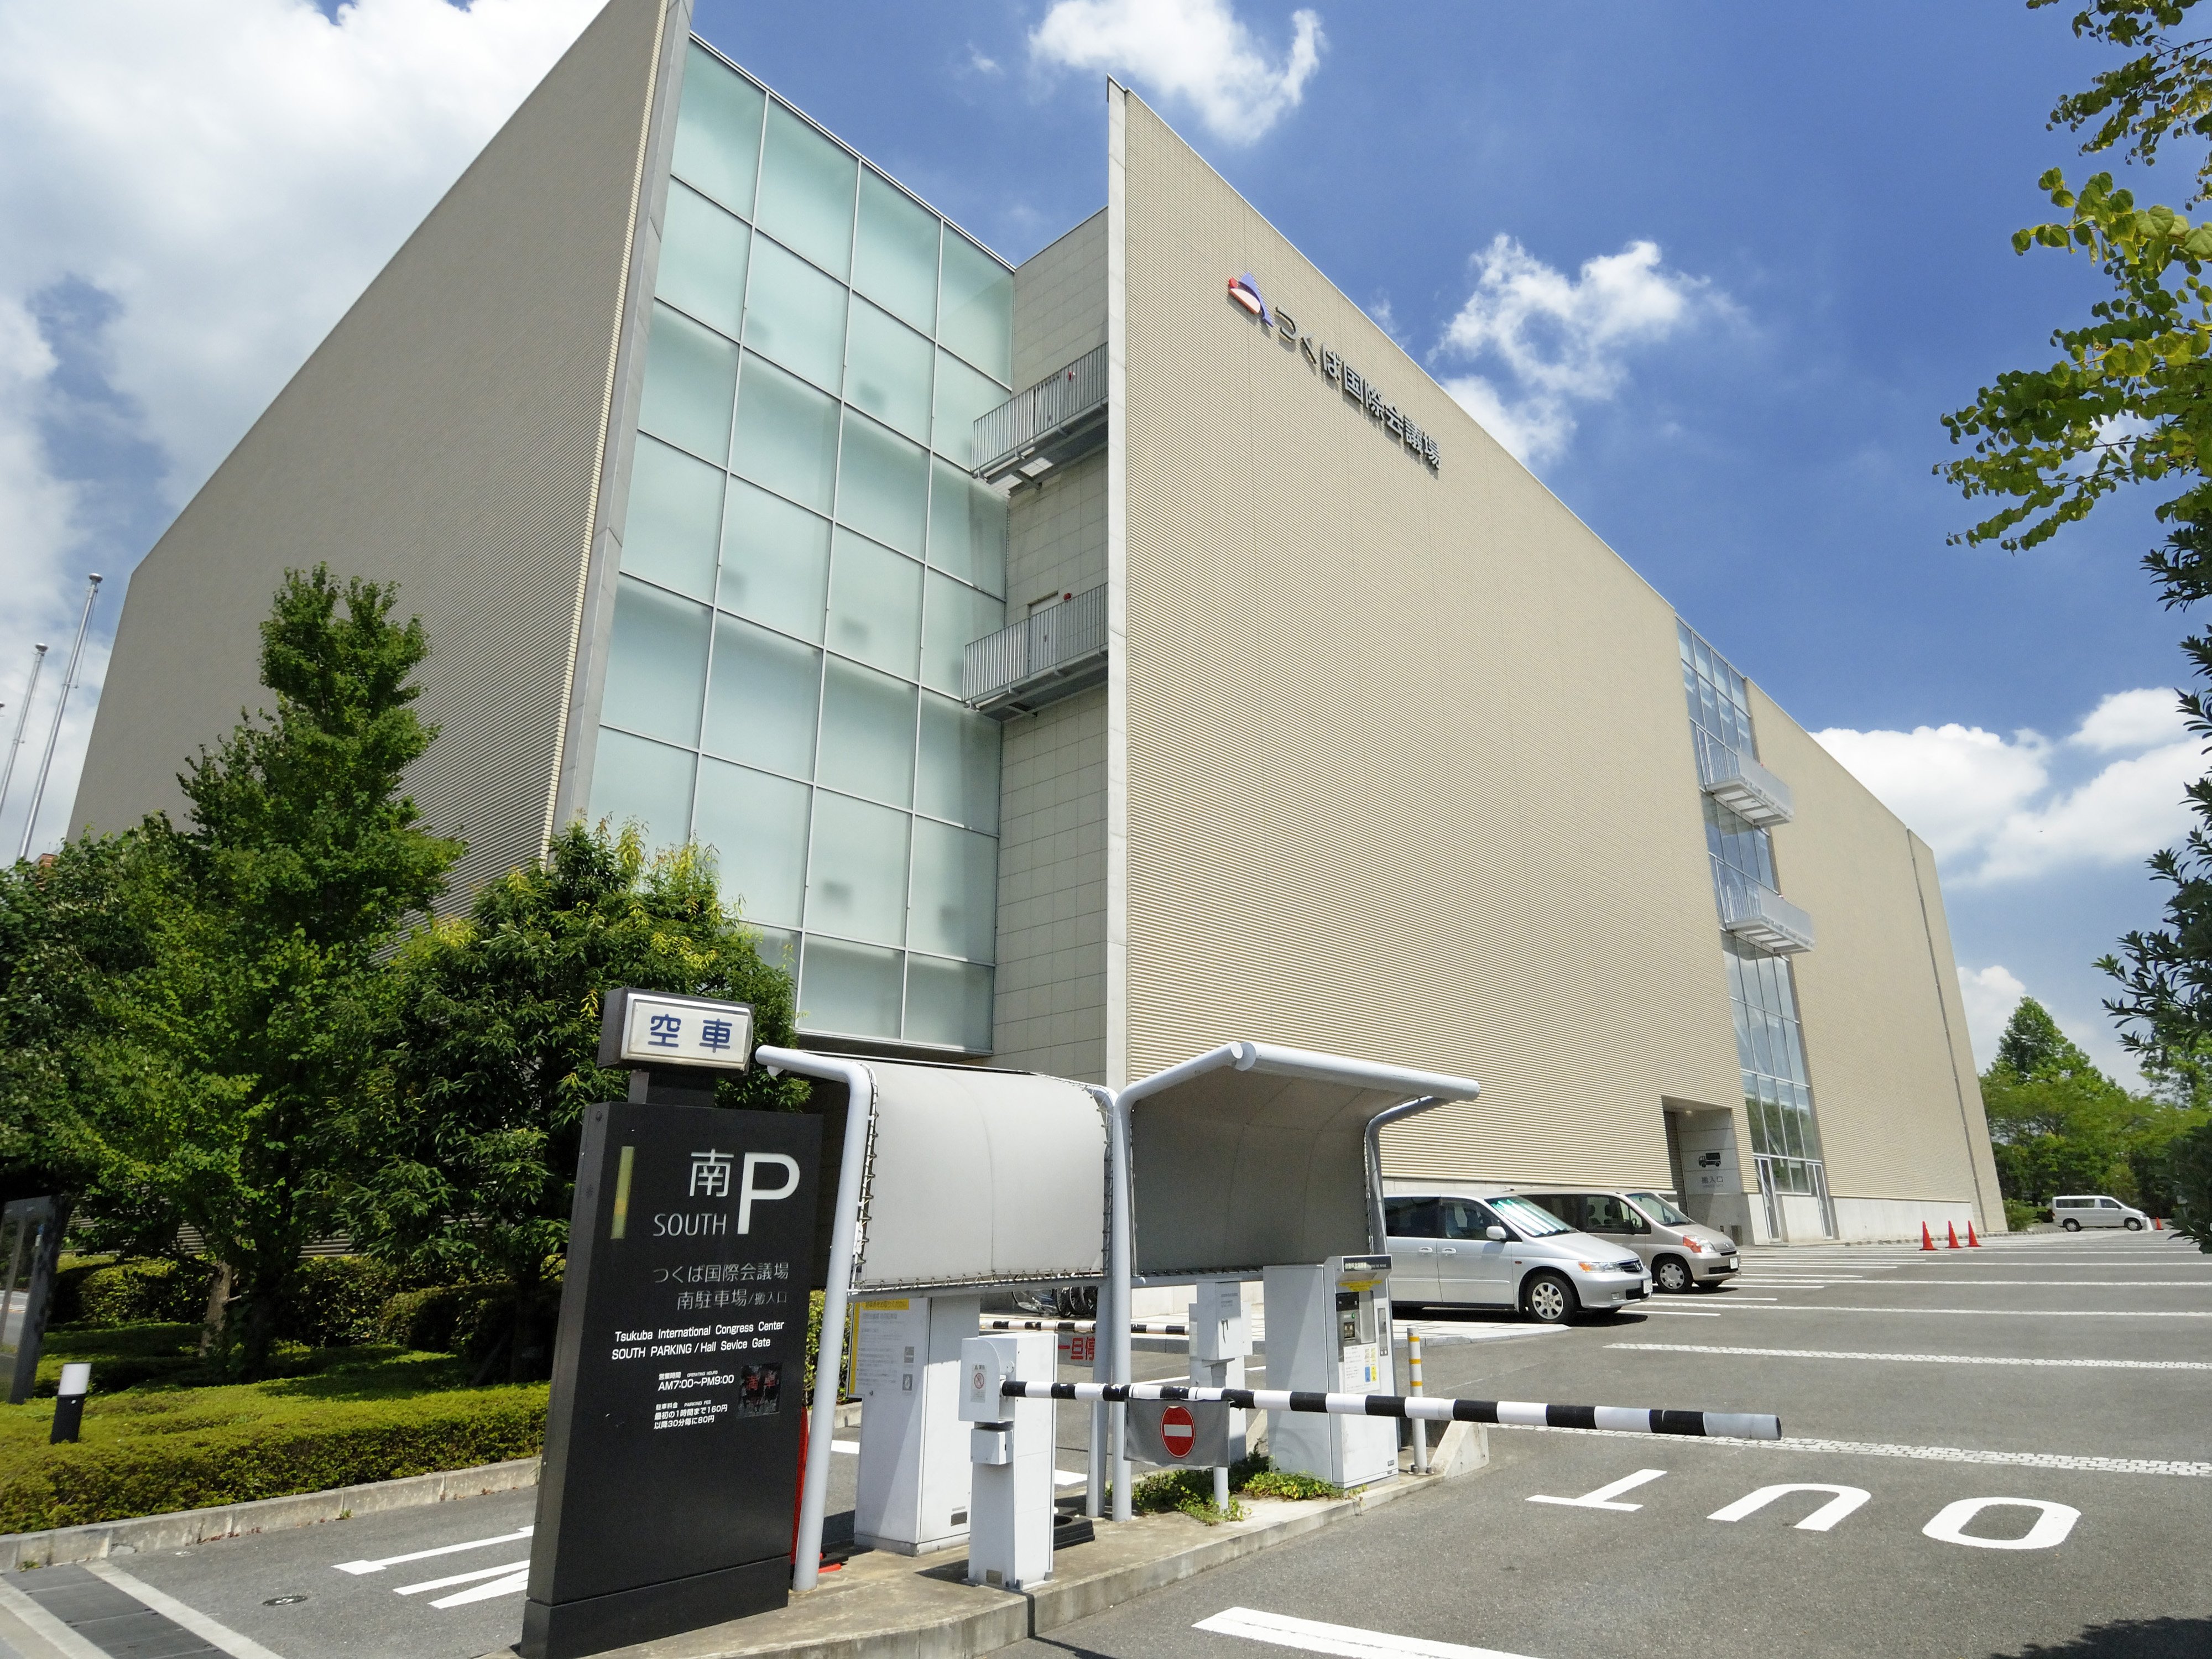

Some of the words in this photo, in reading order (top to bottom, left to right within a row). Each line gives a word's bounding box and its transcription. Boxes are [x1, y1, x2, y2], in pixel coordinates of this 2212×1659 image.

[1275, 305, 1440, 469] つくば国際会議場
[648, 1013, 733, 1053] 空車
[690, 1149, 734, 1197] 南
[737, 1151, 800, 1235] P
[653, 1213, 727, 1237] SOUTH
[653, 1262, 789, 1283] つくば国際会議場
[615, 1330, 653, 1342] Tsukuba
[658, 1326, 711, 1339] International
[716, 1323, 754, 1335] Congress
[758, 1321, 785, 1332] Center
[612, 1347, 646, 1360] SOUTH
[721, 1339, 747, 1350] Sevice
[752, 1337, 771, 1348] Gate
[654, 1404, 728, 1420] 最初の1時間まで160円
[1526, 1468, 2081, 1550] OUT
